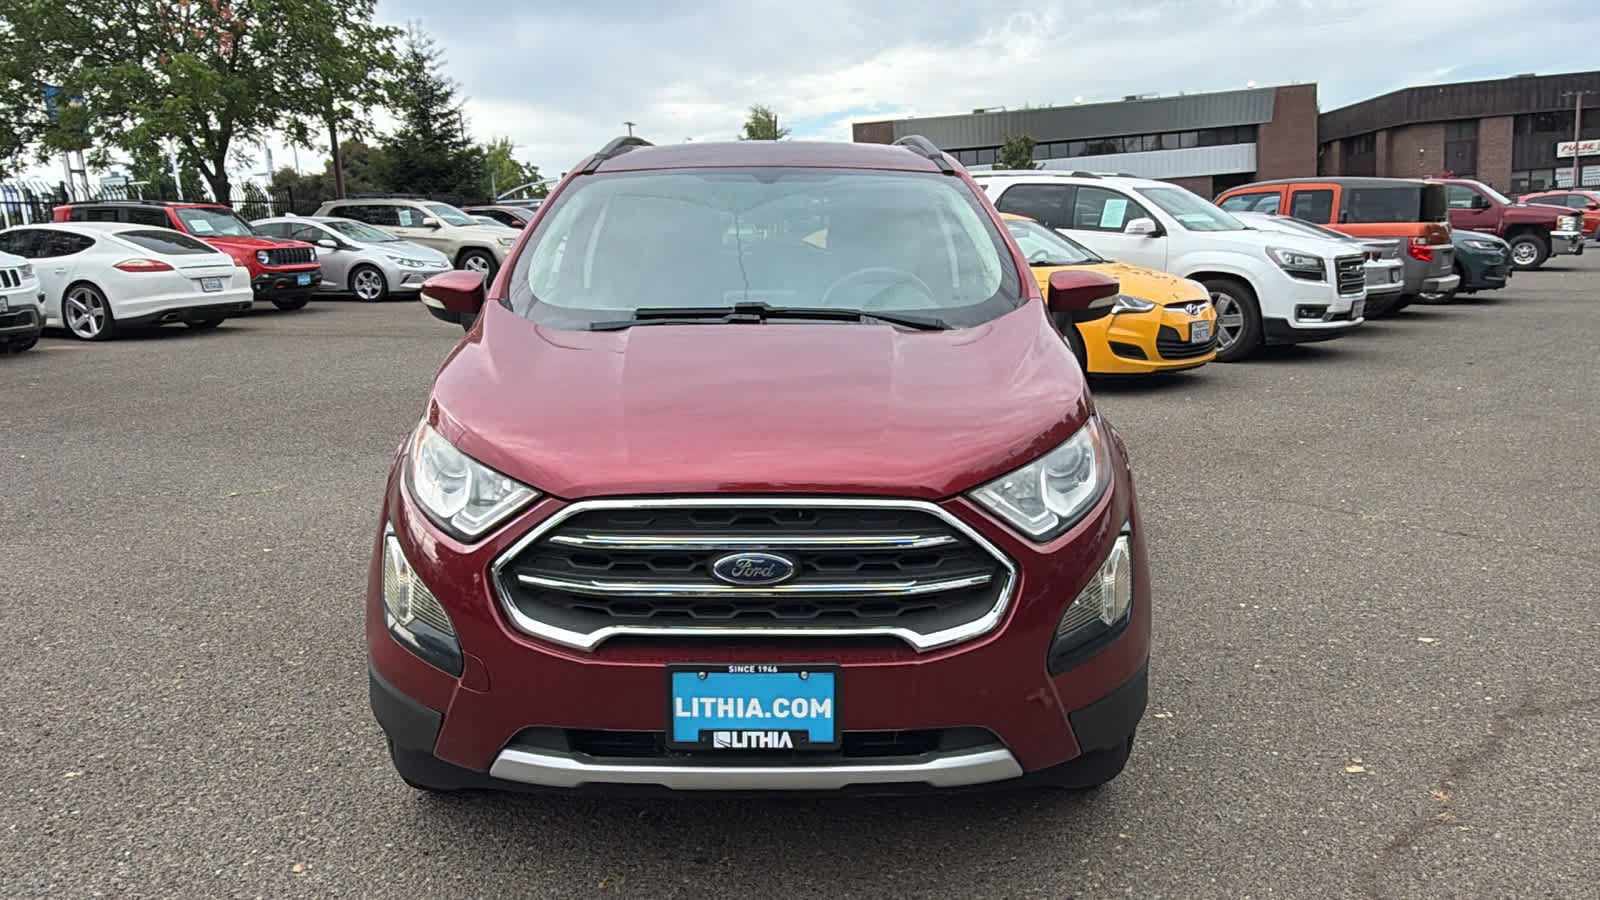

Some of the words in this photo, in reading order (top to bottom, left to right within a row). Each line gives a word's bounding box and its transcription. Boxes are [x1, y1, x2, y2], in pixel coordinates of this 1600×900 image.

[731, 558, 776, 577] Ford
[728, 665, 756, 673] SINCE
[758, 665, 778, 673] 1946
[675, 697, 832, 718] LITHIA.COM
[732, 731, 794, 748] LITHIA
